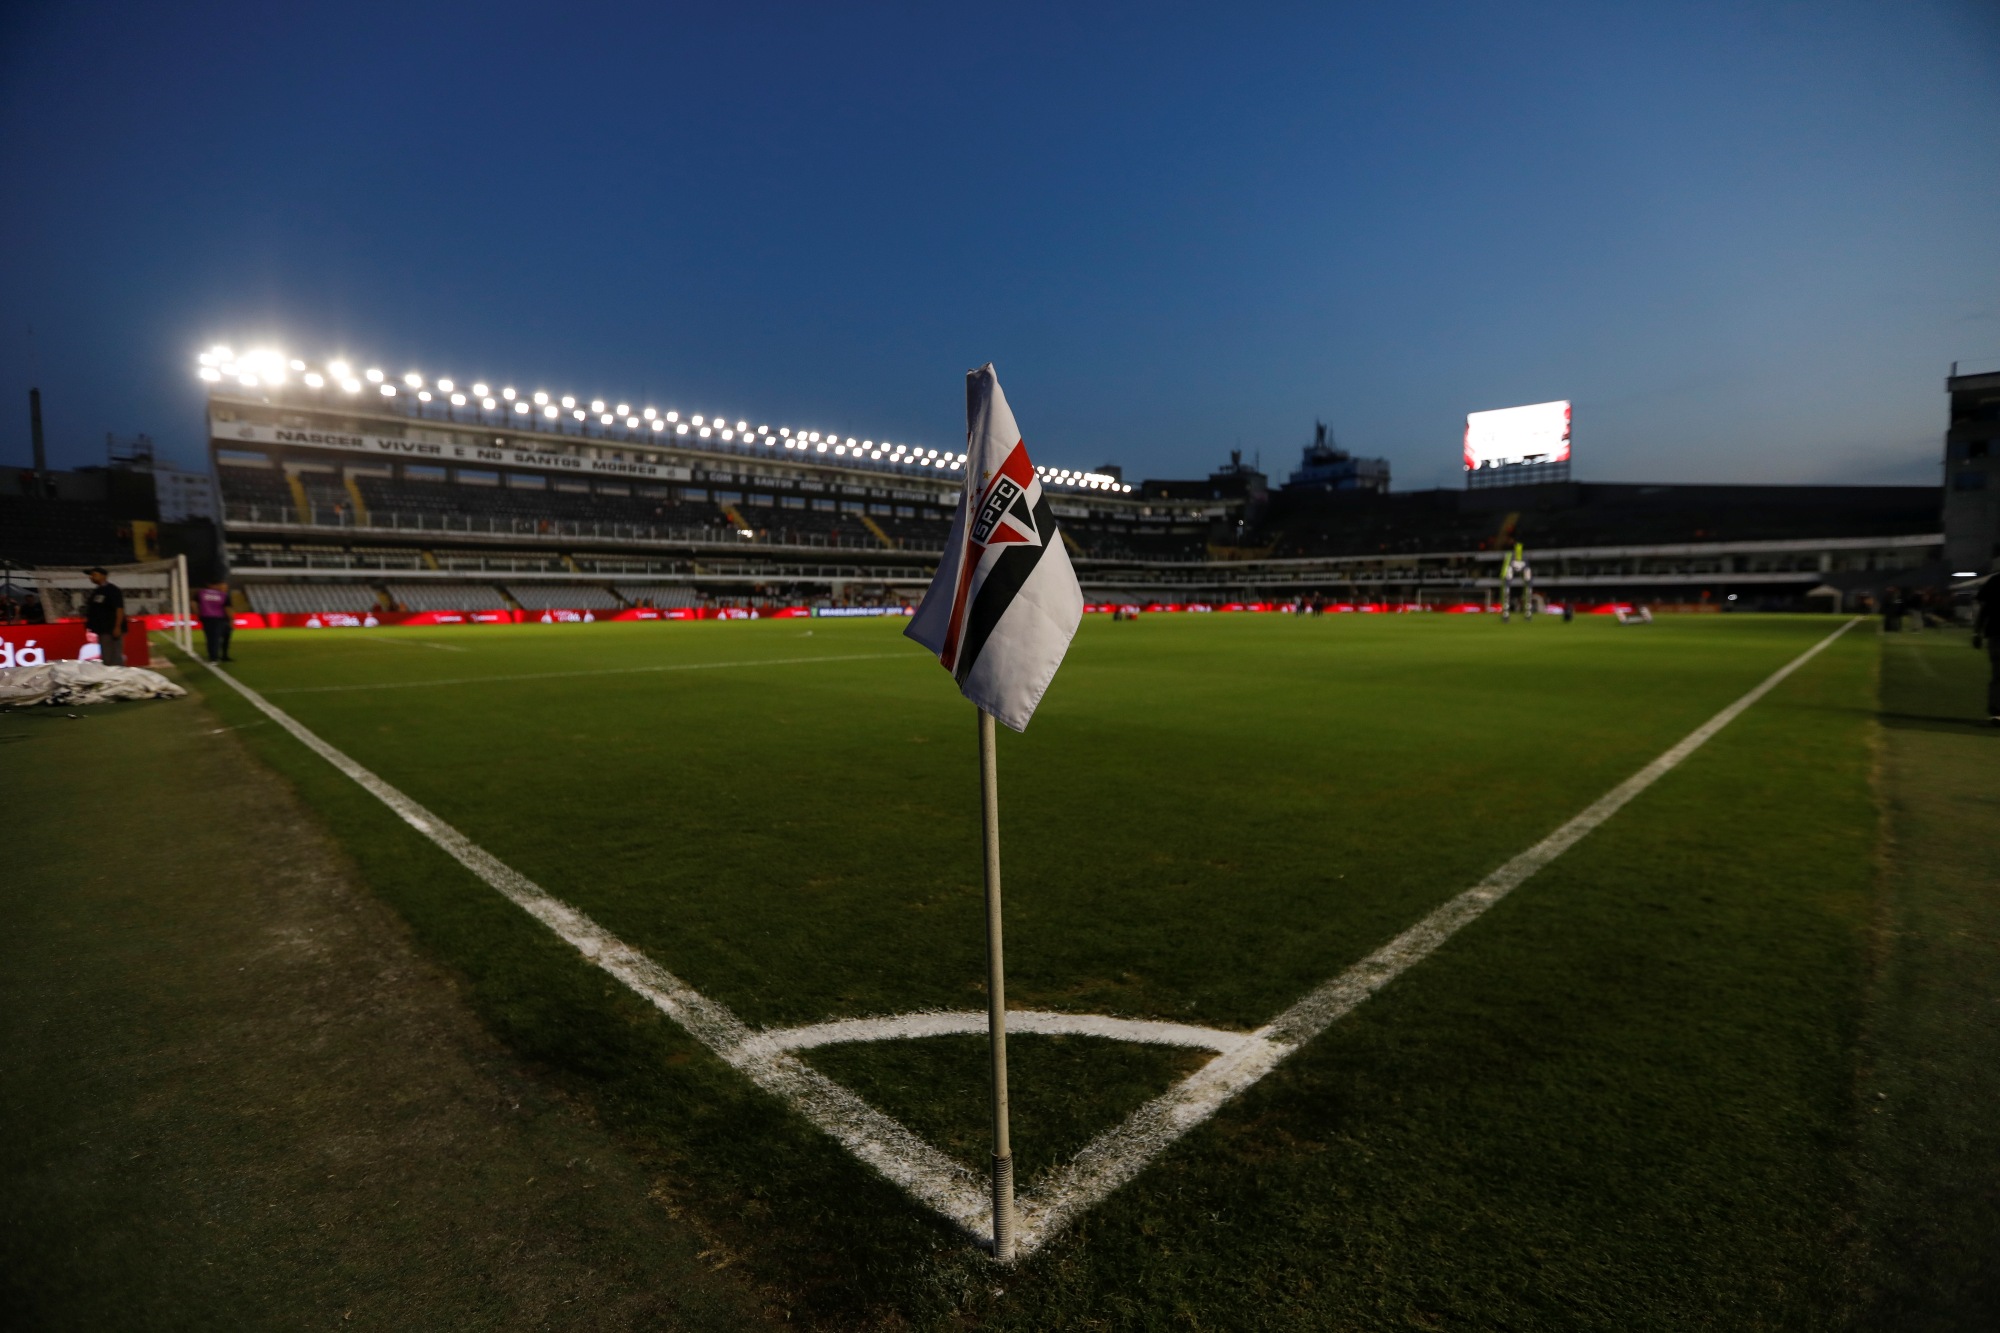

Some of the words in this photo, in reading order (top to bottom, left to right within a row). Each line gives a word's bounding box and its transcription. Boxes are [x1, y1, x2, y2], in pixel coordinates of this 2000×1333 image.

[276, 430, 363, 447] NASCER
[378, 439, 441, 455] VIVER
[454, 447, 465, 457] E
[477, 449, 503, 460] NO
[514, 453, 581, 469] SANTOS
[592, 460, 657, 475] MORRER
[709, 472, 733, 483] COM
[753, 476, 794, 488] SANTOS
[975, 483, 1015, 538] SPFC
